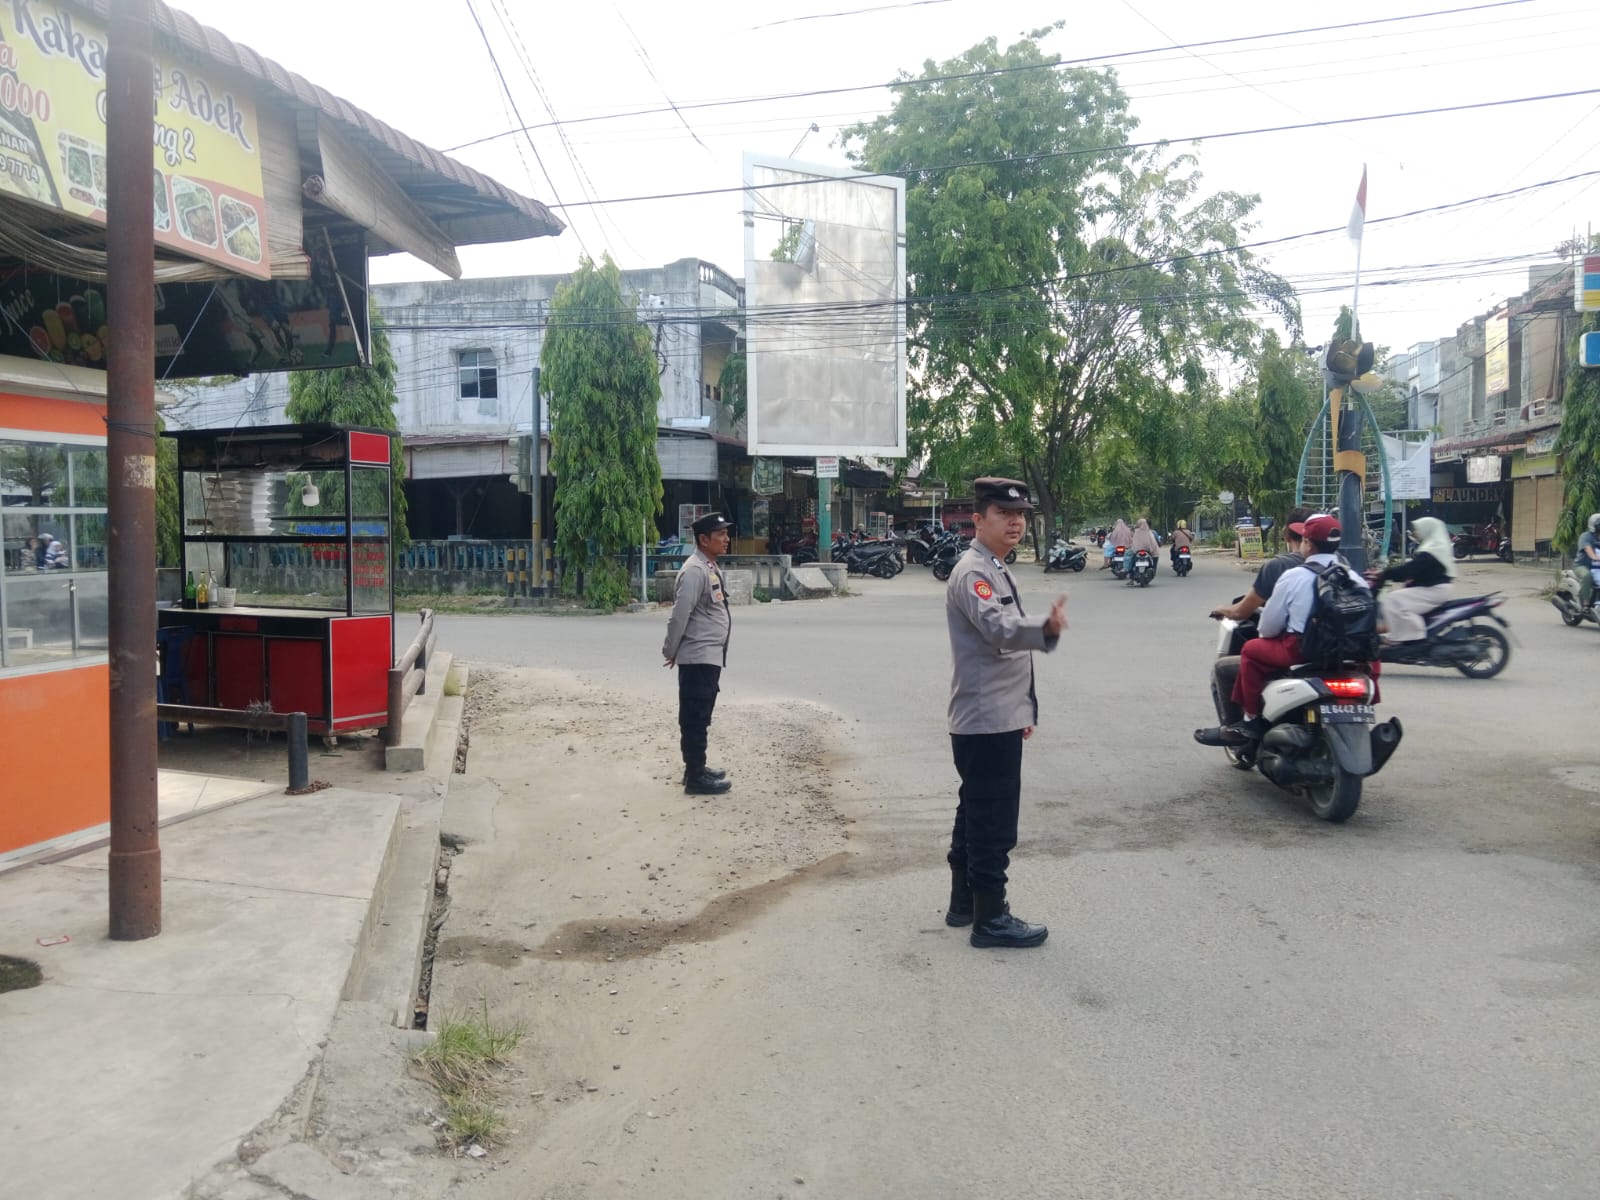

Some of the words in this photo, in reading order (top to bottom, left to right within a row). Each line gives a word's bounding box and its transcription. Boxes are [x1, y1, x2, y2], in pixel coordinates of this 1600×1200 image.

[170, 71, 252, 150] Adek
[1444, 487, 1504, 503] LAUNDRY
[1319, 704, 1332, 714] BL
